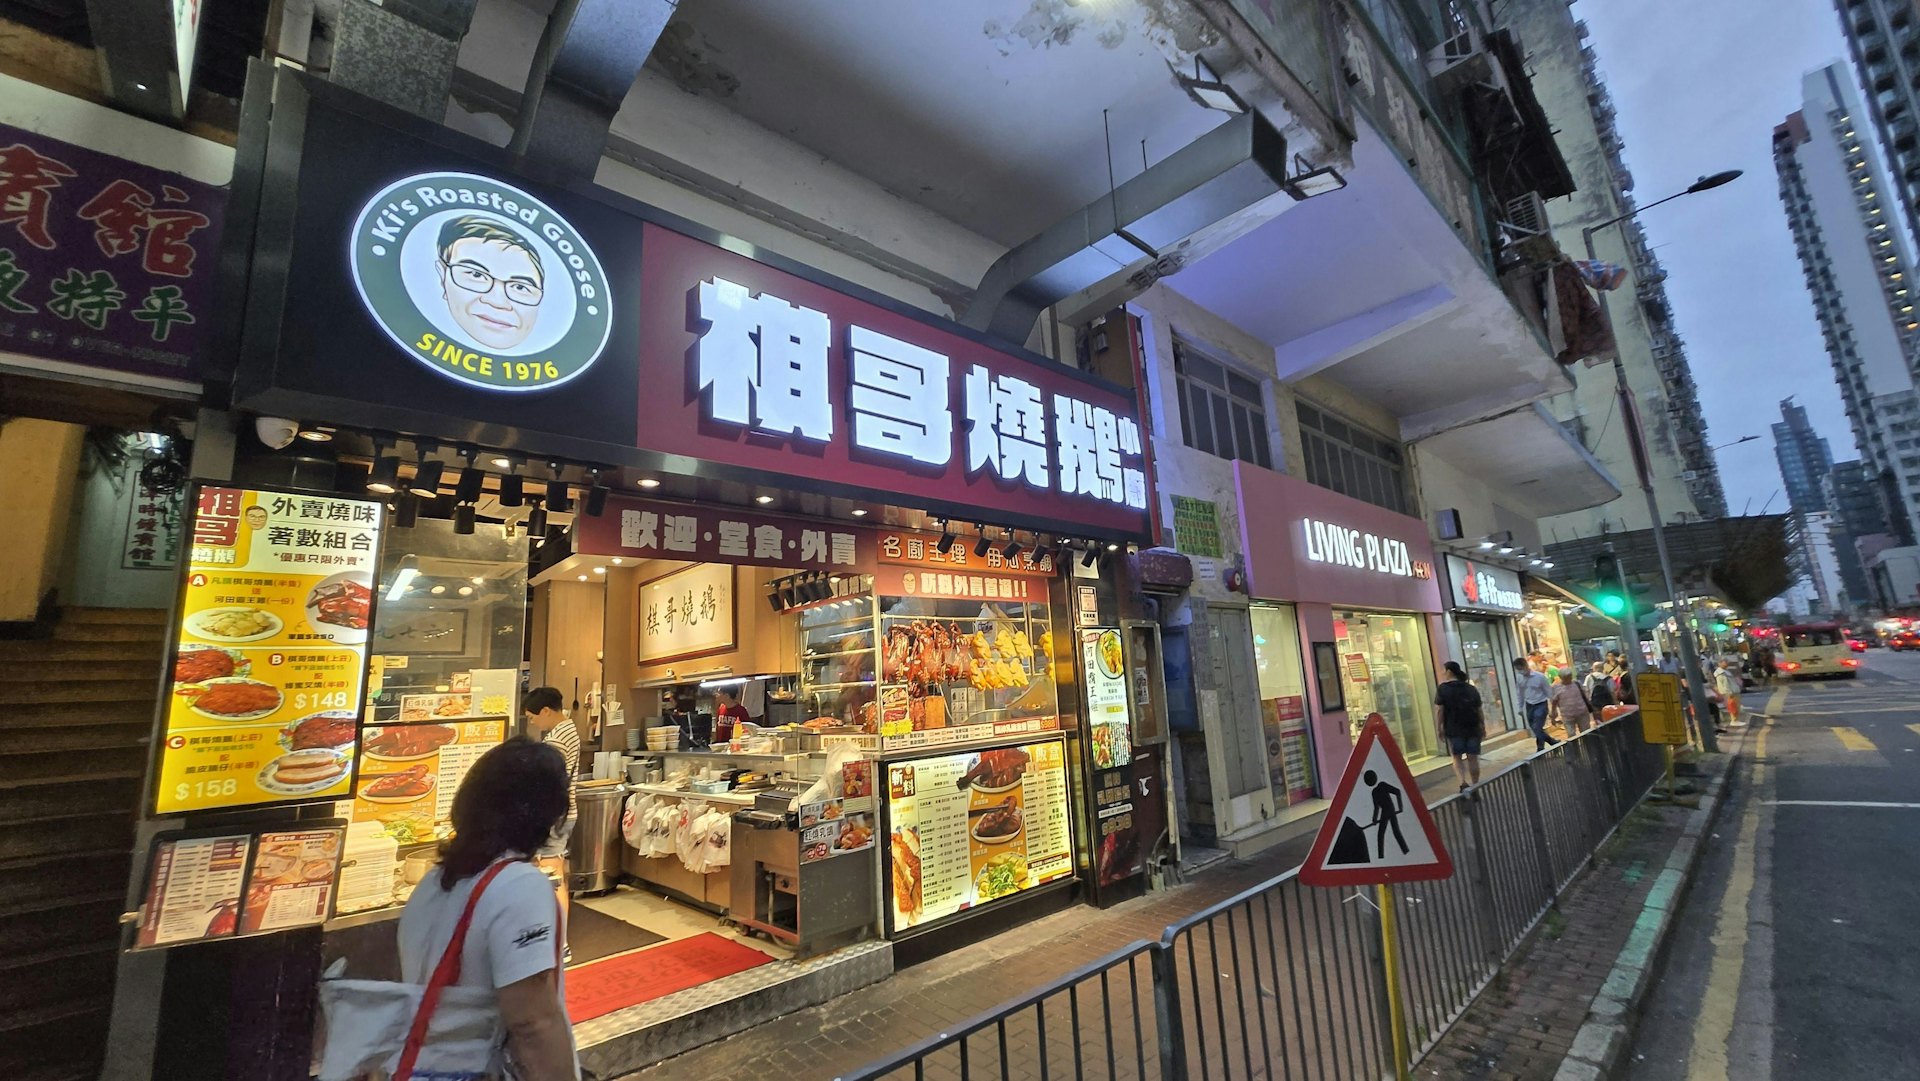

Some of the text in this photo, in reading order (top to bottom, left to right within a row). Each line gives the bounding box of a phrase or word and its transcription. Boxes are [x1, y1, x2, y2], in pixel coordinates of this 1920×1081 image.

[371, 186, 595, 299] Ki's Roasted Goose
[416, 333, 559, 381] SINCE 1976
[271, 497, 376, 523] 外賣燒味
[268, 526, 373, 551] 著數組合
[1303, 518, 1365, 568] LIVING
[1364, 533, 1412, 576] PLAZA
[193, 575, 205, 586] A
[646, 584, 716, 636] 棋哥燒鵝
[271, 655, 282, 665] B
[294, 691, 347, 709] $148
[169, 737, 183, 748] C
[175, 778, 237, 801] $158
